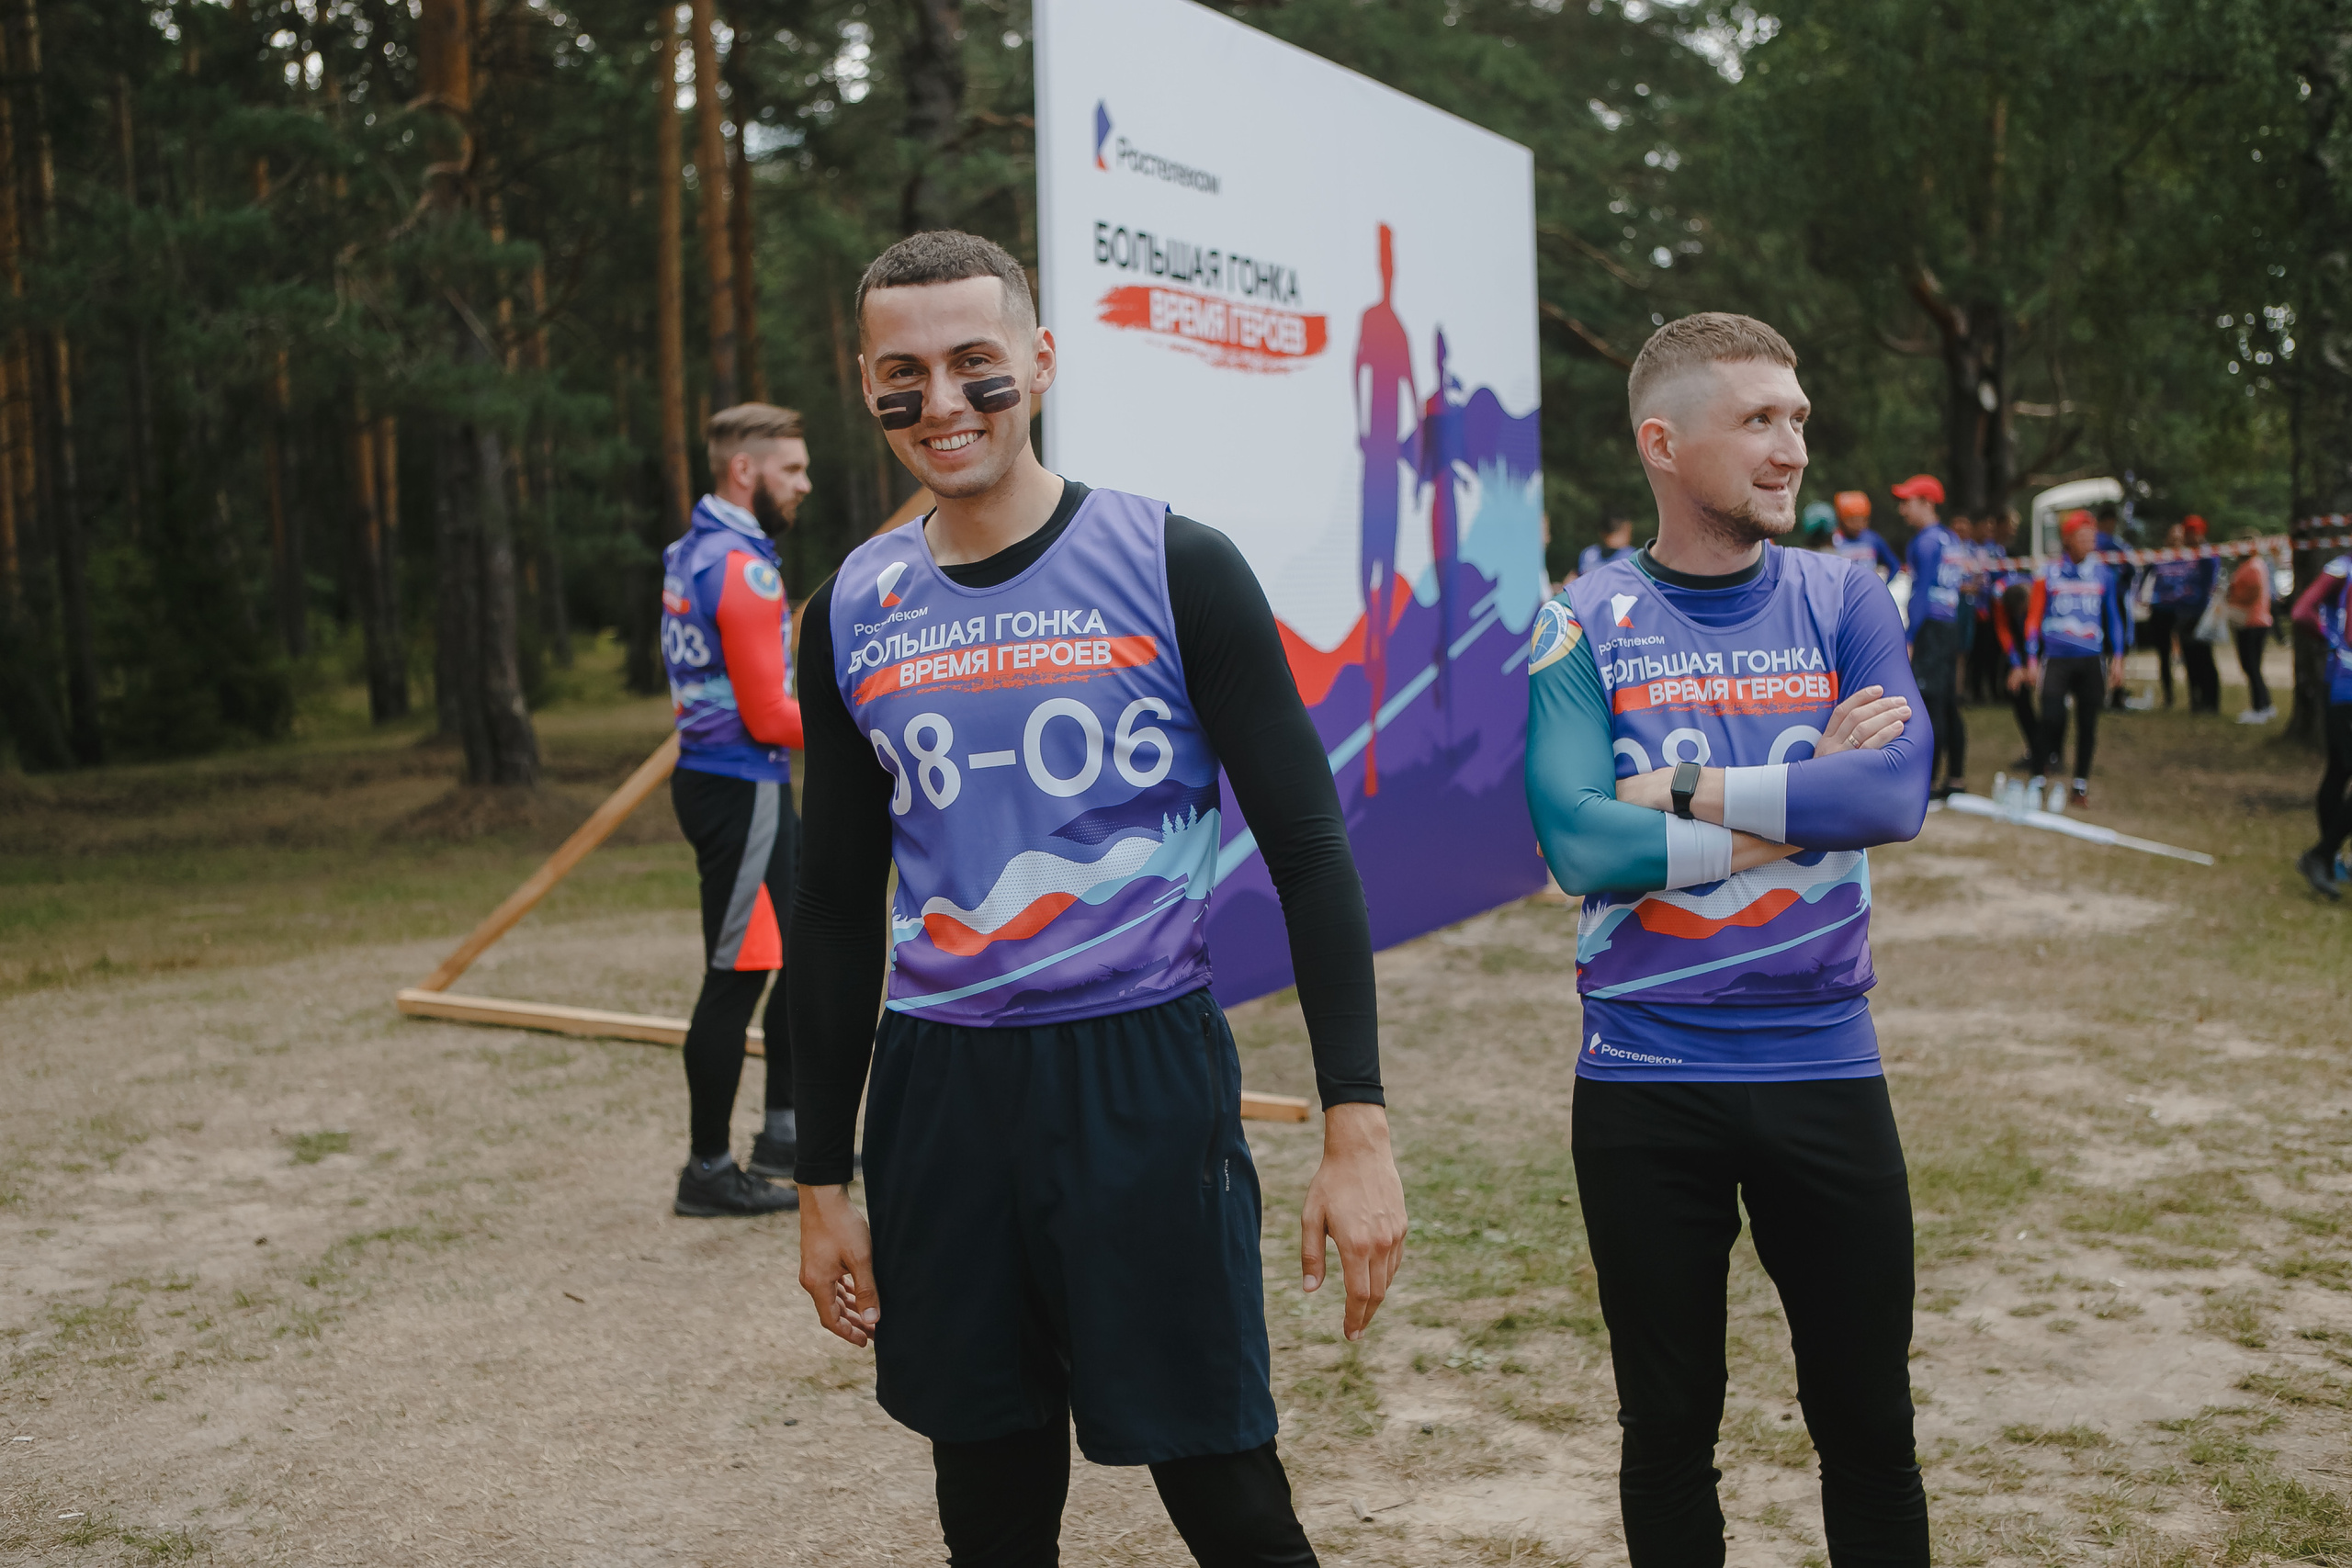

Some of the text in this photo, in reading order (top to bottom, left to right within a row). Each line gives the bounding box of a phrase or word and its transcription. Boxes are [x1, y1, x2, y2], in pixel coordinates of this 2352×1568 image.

[1116, 136, 1220, 195] Ростелеком
[1094, 220, 1303, 306] БОЛЬШАЯ ГОНКА
[1150, 289, 1307, 355] ВРЕМЯ ГЕРОЕВ
[848, 608, 1108, 674] БОЛЬШАЯ ГОНКА
[899, 640, 1113, 688] ВРЕМЯ ГЕРОЕВ
[1600, 647, 1827, 691] БОЛЬШАЯ ГОНКА
[1648, 675, 1831, 706] ВРЕМЯ ГЕРОЕВ
